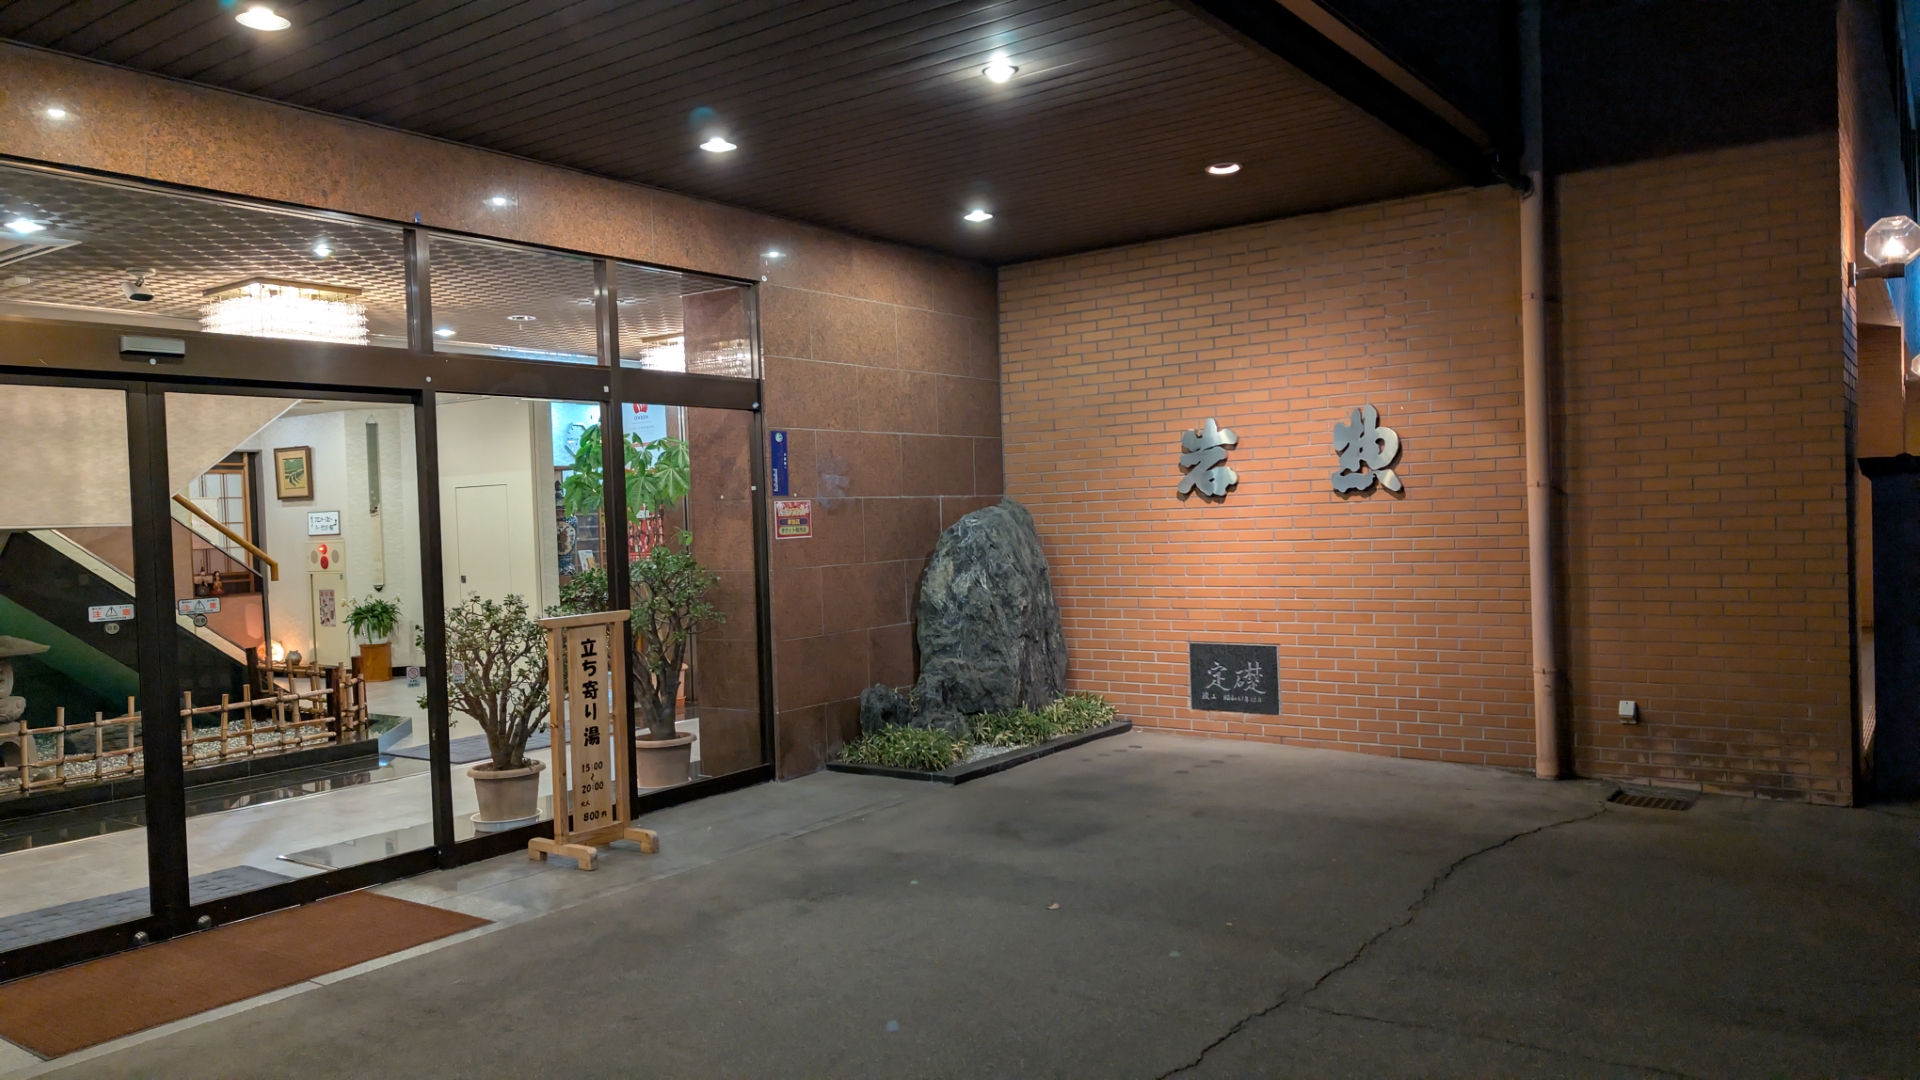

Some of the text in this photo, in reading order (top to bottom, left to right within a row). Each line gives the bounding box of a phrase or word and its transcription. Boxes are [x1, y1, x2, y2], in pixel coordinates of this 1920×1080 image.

[1205, 660, 1266, 695] 定礎
[581, 638, 601, 747] 立ち寄り湯
[581, 761, 603, 773] 15:00
[581, 781, 604, 794] 20:00
